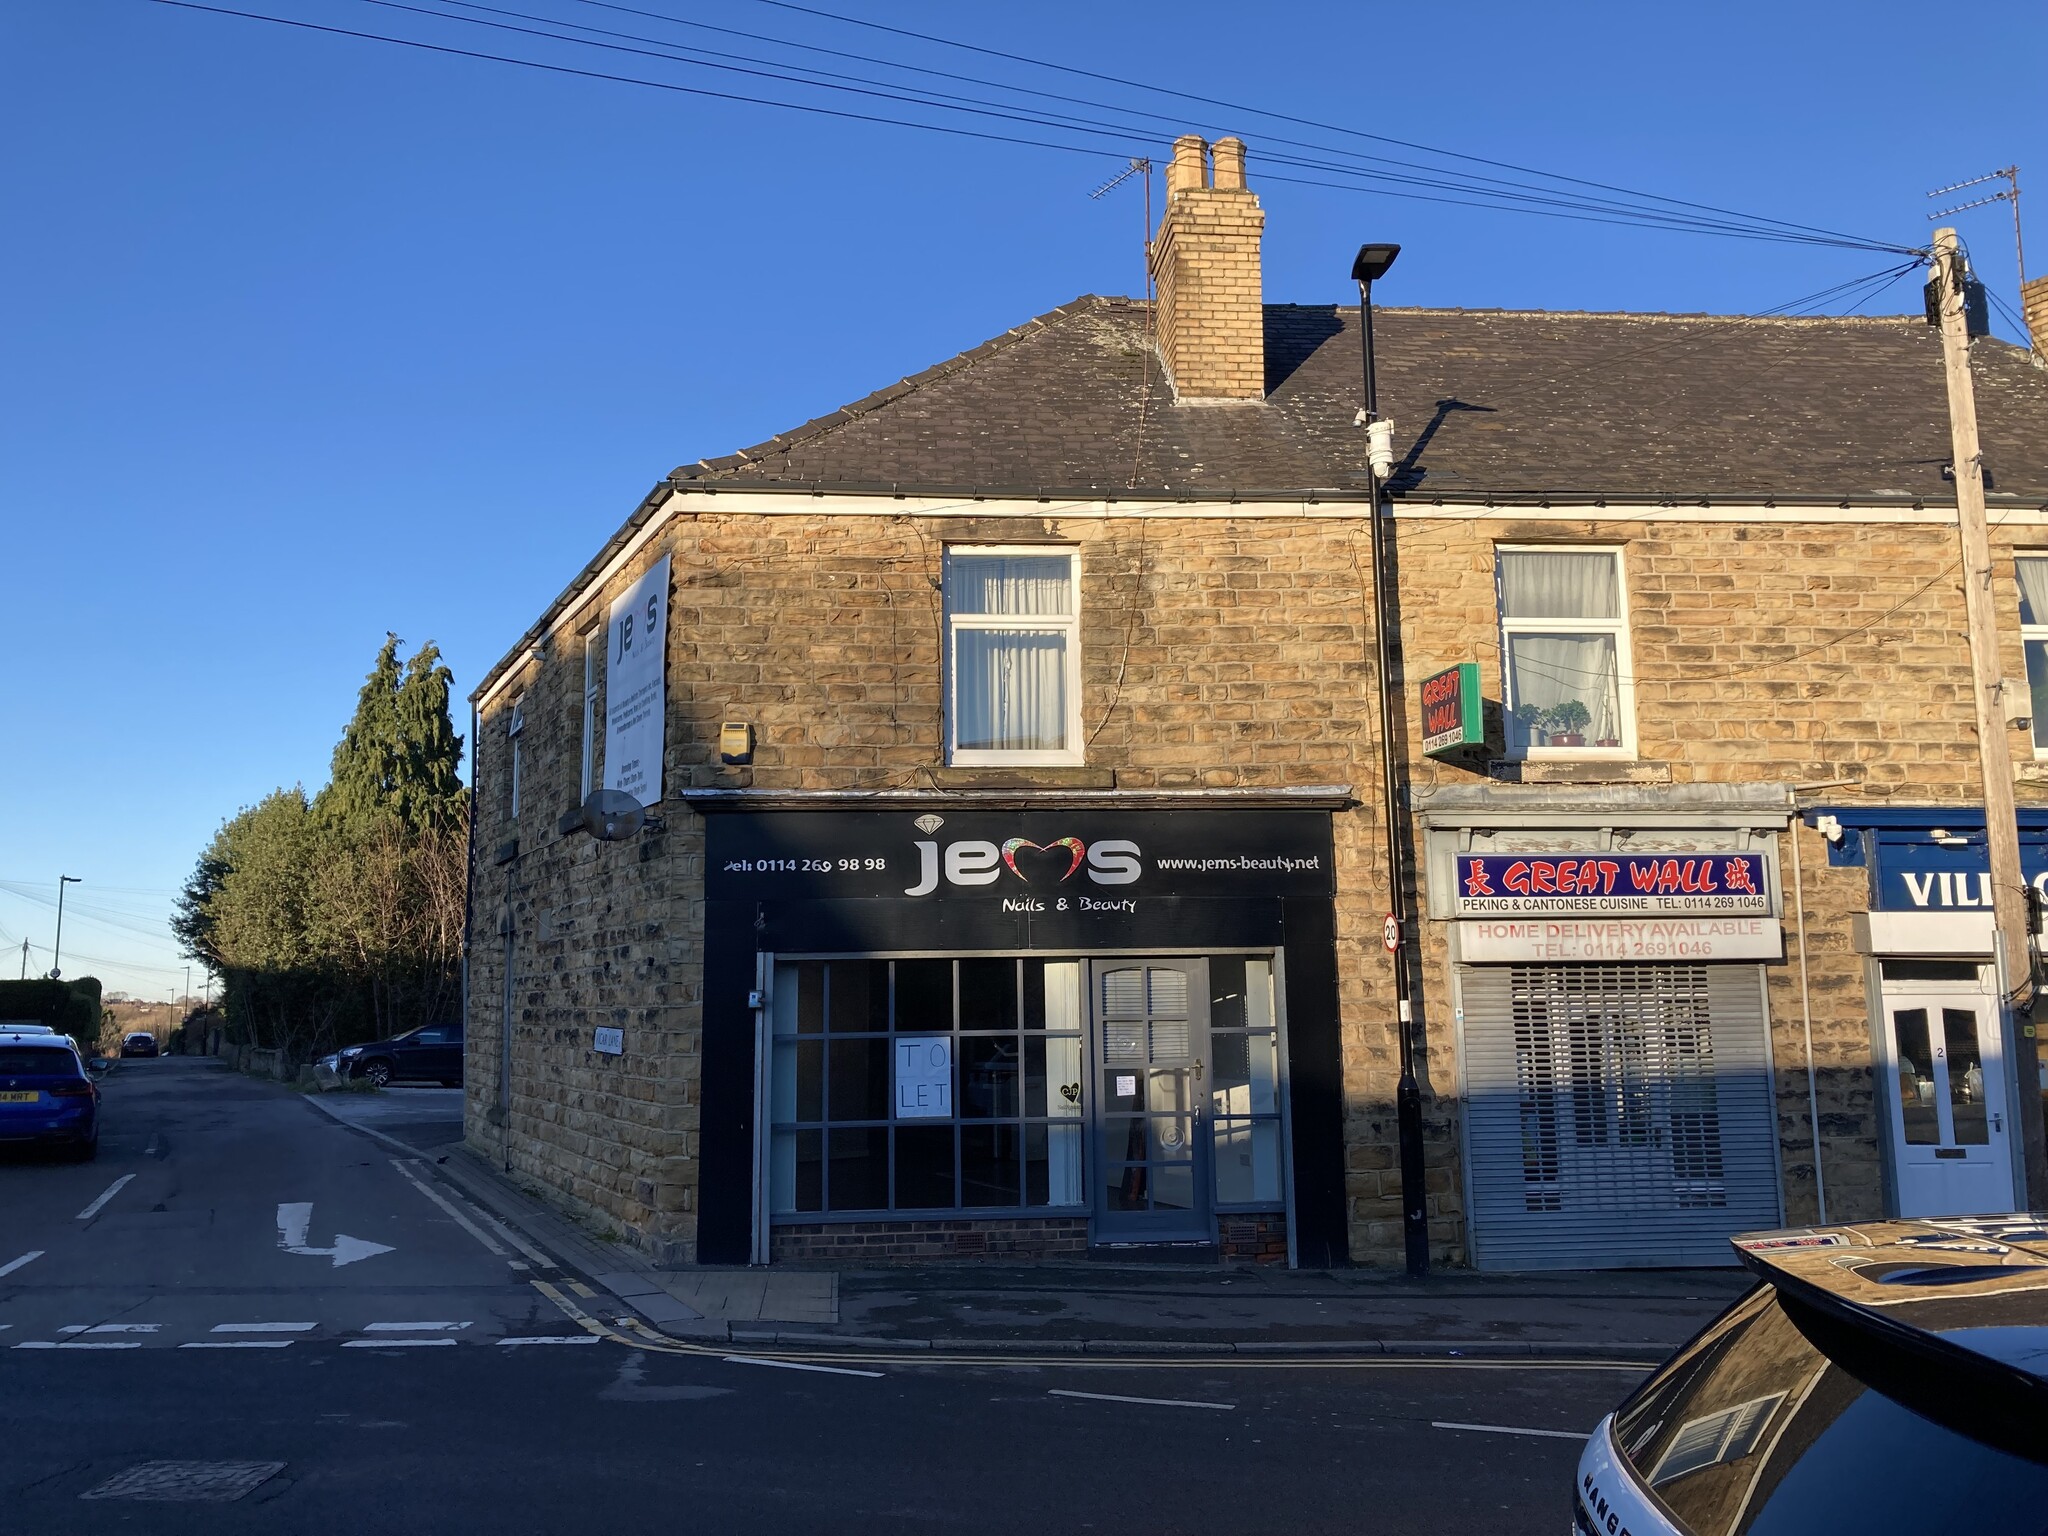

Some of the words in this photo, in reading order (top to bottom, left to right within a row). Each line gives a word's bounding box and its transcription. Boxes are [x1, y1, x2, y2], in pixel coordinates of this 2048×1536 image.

[1423, 670, 1460, 707] GREAT
[1428, 702, 1457, 733] WALL
[904, 814, 1142, 896] jems
[756, 859, 796, 872] 0114
[801, 859, 832, 873] 269
[838, 858, 860, 871] 98
[864, 858, 886, 870] 98
[1503, 860, 1620, 895] GREAT
[1629, 859, 1717, 894] WALL
[1002, 898, 1045, 913] Nails
[1056, 898, 1069, 911] &
[1079, 897, 1137, 913] Beauty
[1464, 899, 1508, 910] PEKING
[1512, 899, 1521, 910] &
[1524, 899, 1597, 910] CANTONESE
[1600, 898, 1648, 909] CUISINE
[1656, 898, 1681, 909] TEL:
[1685, 897, 1711, 908] 0114
[1714, 897, 1734, 908] 269
[1739, 896, 1764, 908] 1046
[1386, 925, 1396, 940] 20
[1478, 924, 1539, 939] HOME
[1546, 922, 1647, 938] DELIVERY
[1650, 921, 1763, 937] AVAILABLE
[1532, 943, 1576, 957] TEL:
[1583, 942, 1627, 957] 0114
[1633, 941, 1712, 955] 2691046
[900, 1044, 946, 1068] TO
[1937, 1047, 1944, 1058] 2
[901, 1083, 947, 1107] LET
